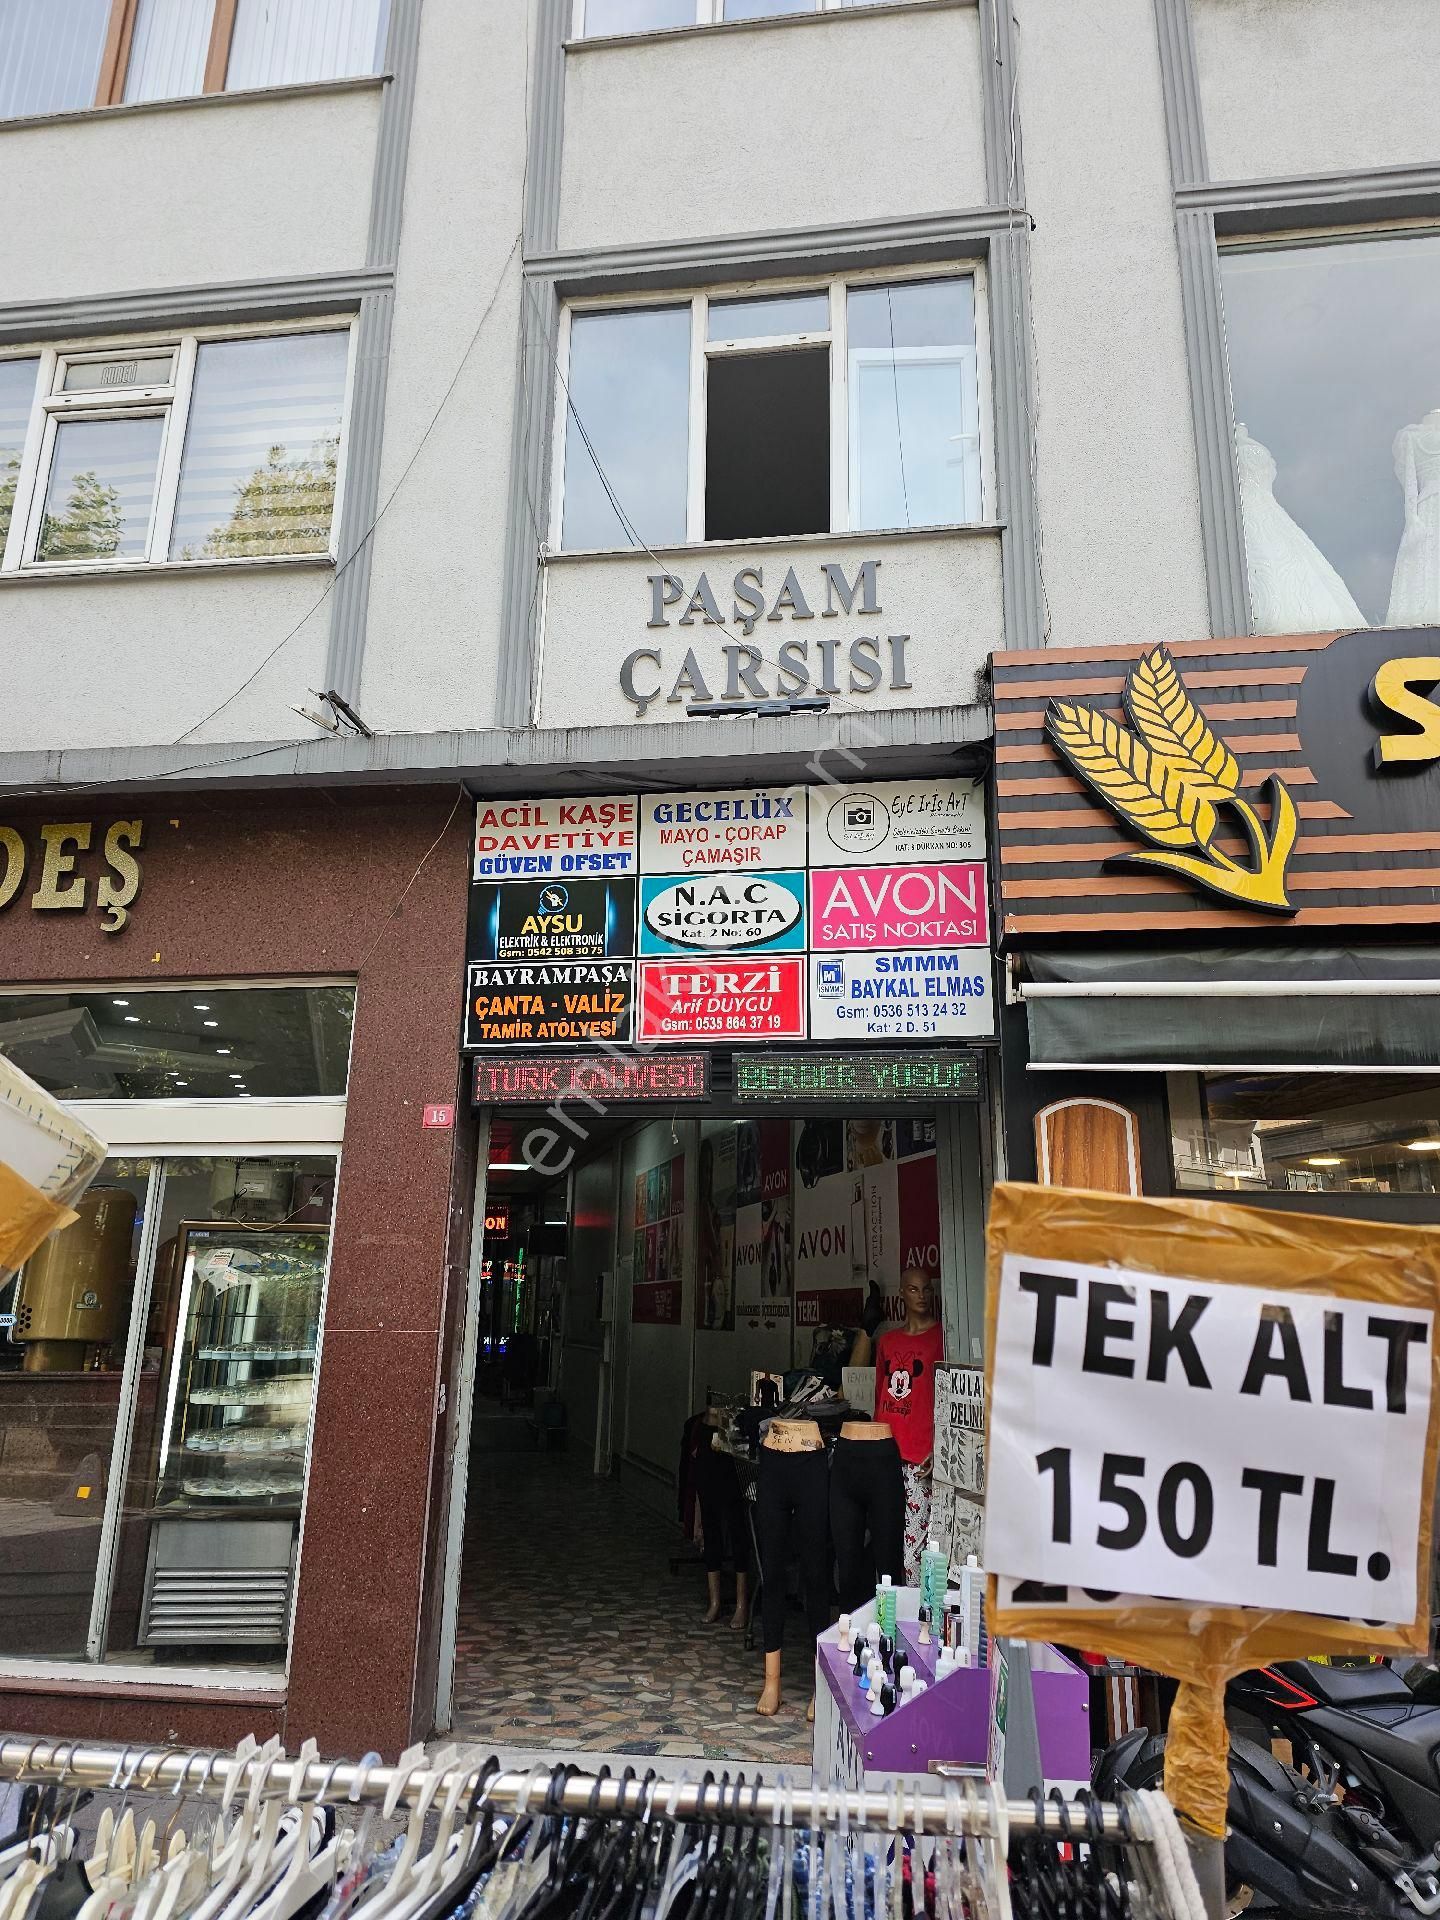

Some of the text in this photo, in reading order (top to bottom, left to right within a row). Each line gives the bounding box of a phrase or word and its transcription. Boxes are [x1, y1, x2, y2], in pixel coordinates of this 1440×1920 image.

[647, 560, 882, 636] PAŞAM
[479, 803, 634, 829] ACİL KAŞE
[653, 793, 794, 824] GECELÜX
[478, 829, 635, 852] DAVETİYE
[660, 827, 709, 845] MAYO
[725, 825, 787, 846] ÇORAP
[479, 852, 632, 875] GÜVEN OFSET
[682, 847, 762, 868] ÇAMAŞIR
[675, 883, 768, 907] N.A.C
[822, 870, 977, 919] AVON
[520, 914, 583, 935] AYSU
[657, 908, 787, 926] SİGORTA
[499, 932, 604, 949] ELEKTRİK & ELEKTRONİK
[709, 929, 718, 937] 2
[721, 928, 742, 937] No:
[746, 927, 762, 937] 60
[823, 919, 977, 942] SATIŞ NOKTASI
[498, 949, 525, 958] Gsm:
[528, 947, 552, 957] 0542
[575, 946, 589, 955] 30
[591, 946, 603, 955] 75
[875, 954, 959, 973] SMMM
[474, 965, 629, 987] BAYRAMPAŞA
[661, 965, 783, 995] TERZİ
[851, 976, 985, 999] BAYKAL ELMAS
[475, 995, 545, 1020] ÇANTA
[564, 988, 625, 1013] VALİZ
[669, 998, 704, 1014] Arif
[836, 1002, 967, 1019] Gsm: 0536 513 24 32
[481, 1016, 616, 1039] TAMİR ATÖLYESİ
[662, 1017, 693, 1032] Gsm:
[750, 1015, 764, 1029] 37
[767, 1014, 781, 1028] 19
[867, 1020, 937, 1033] Kat: 2 D. 51
[432, 1110, 447, 1123] 15
[764, 1168, 788, 1193] AVON
[736, 1242, 762, 1267] AVON
[797, 1225, 847, 1261] AVON
[1018, 1271, 1429, 1415] TEK ALT
[950, 1399, 985, 1429] DELİNİ
[1035, 1446, 1392, 1582] 150 TL.
